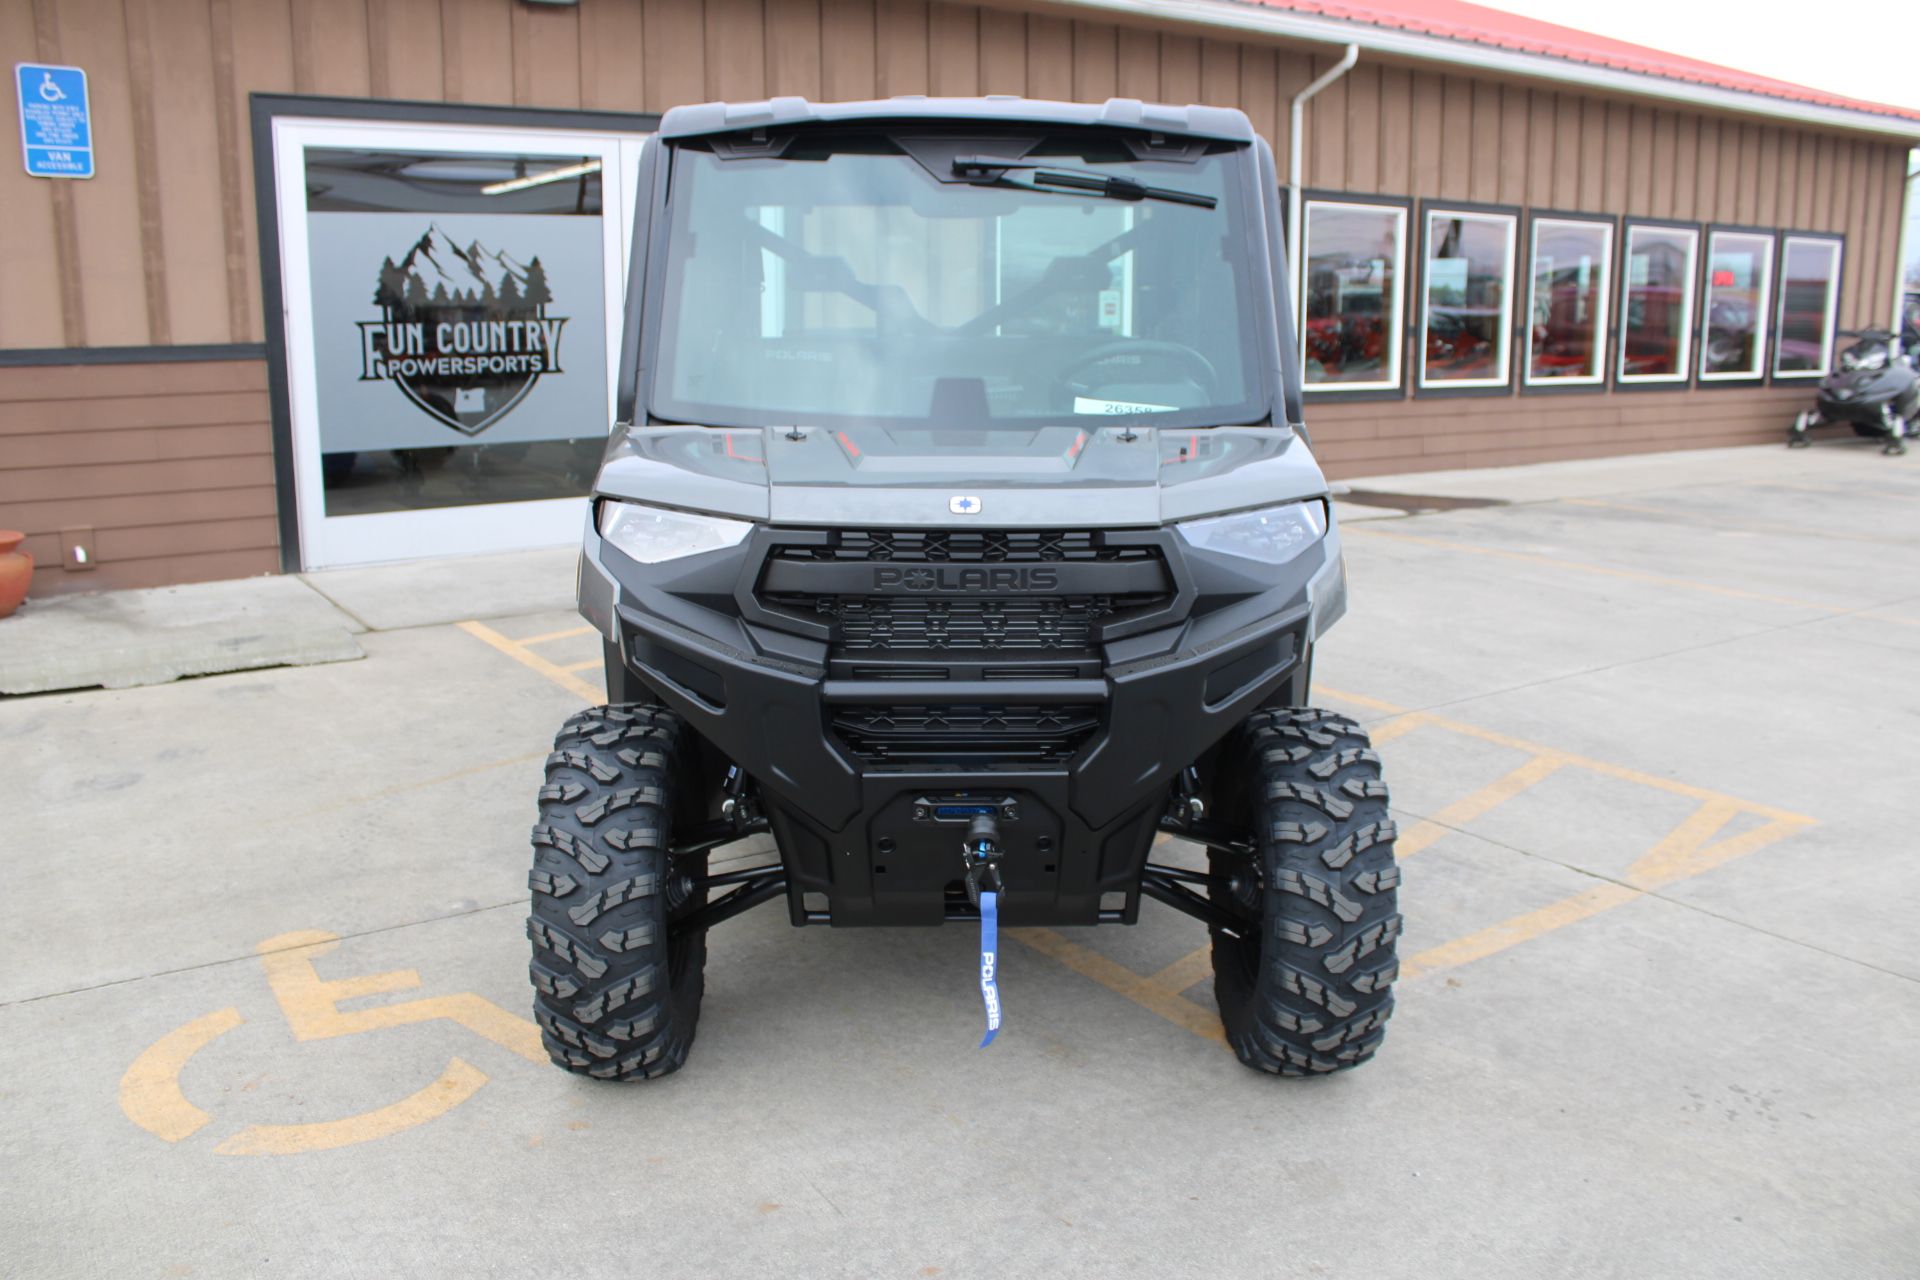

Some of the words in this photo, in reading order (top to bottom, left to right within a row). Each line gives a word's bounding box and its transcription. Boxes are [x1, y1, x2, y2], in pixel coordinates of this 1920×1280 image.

[47, 151, 71, 162] VAN
[358, 319, 424, 380] FUN
[436, 317, 568, 373] COUNTRY
[765, 349, 832, 361] POLARIS
[388, 354, 543, 378] POWERSPORTS
[873, 567, 1058, 592] POLARIS
[982, 952, 1000, 1031] POLARIS
